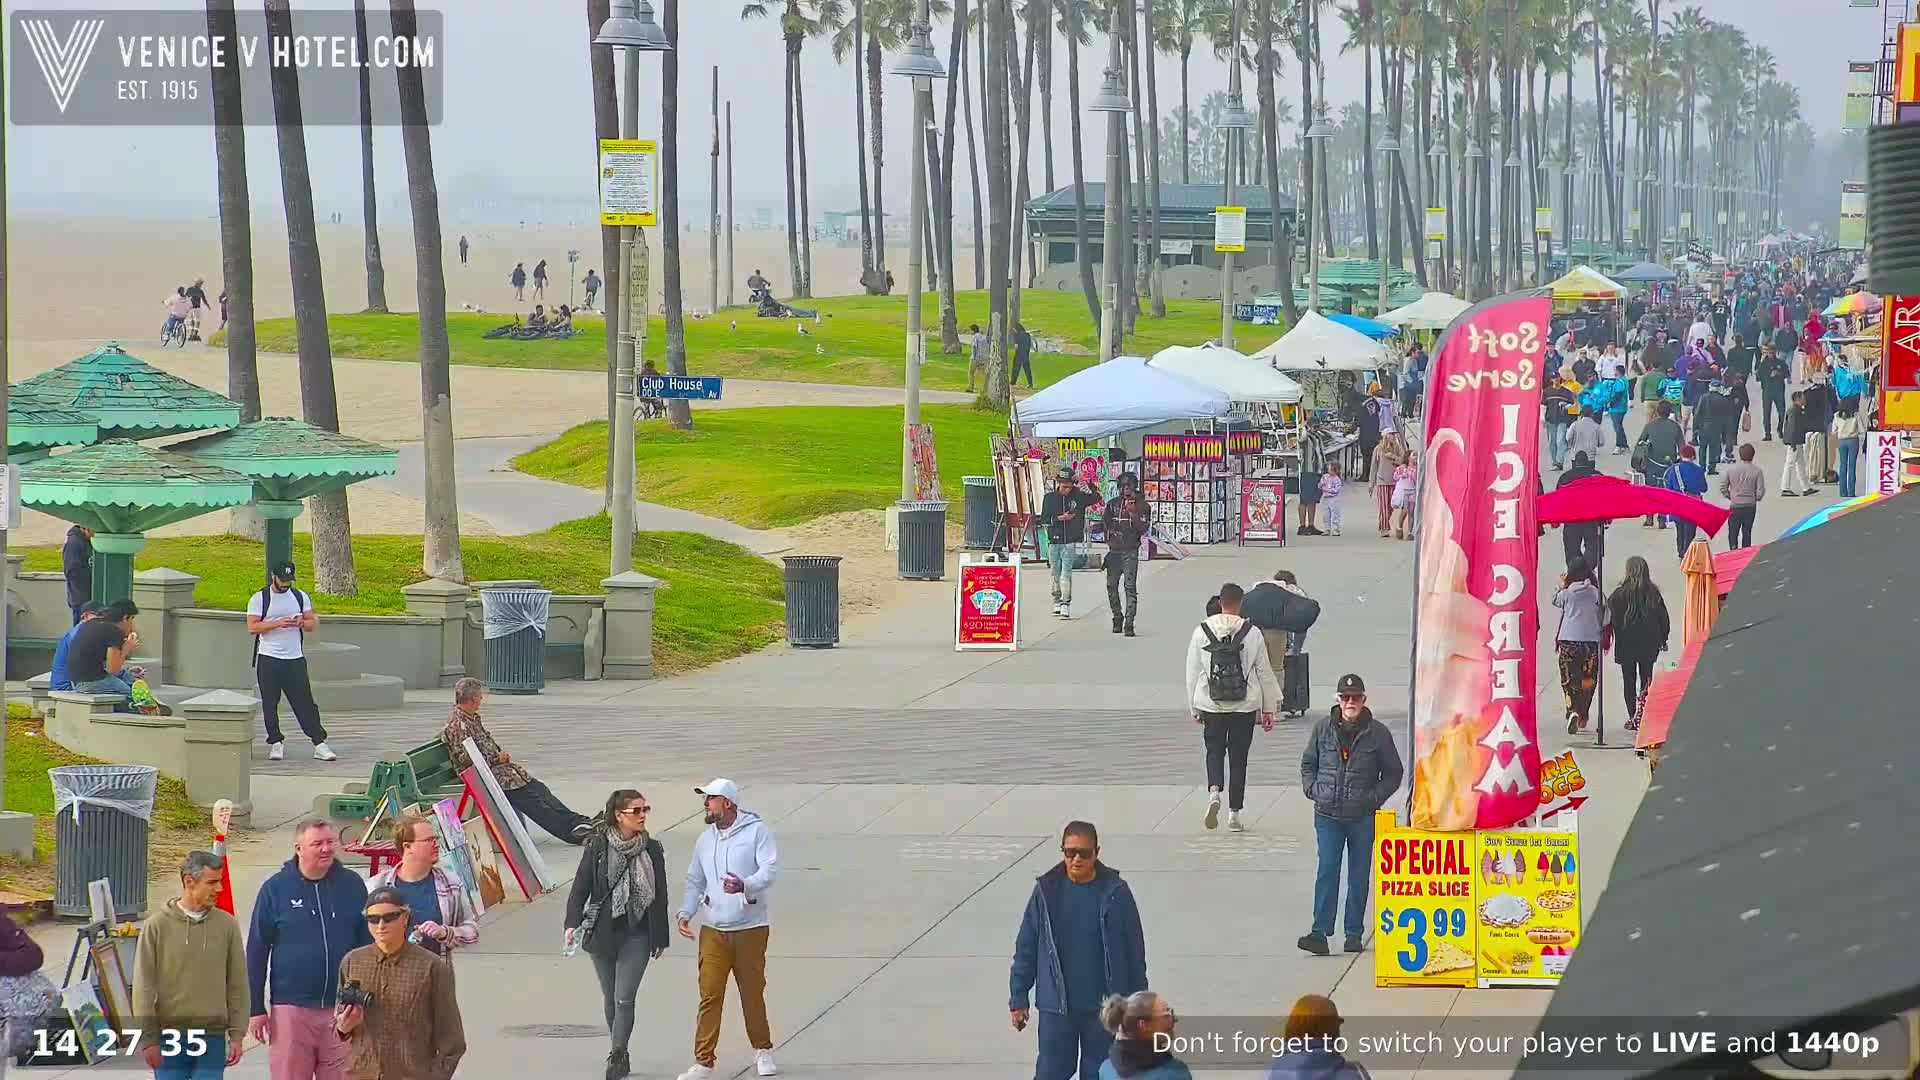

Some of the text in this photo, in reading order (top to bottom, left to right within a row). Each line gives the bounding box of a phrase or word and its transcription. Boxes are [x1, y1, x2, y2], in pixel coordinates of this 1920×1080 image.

[1894, 295, 1920, 357] AR
[642, 377, 702, 390] Club House
[1058, 439, 1084, 459] TTOO
[1144, 437, 1223, 461] HENNA TATTOO
[1229, 432, 1261, 451] ATTOO
[1879, 435, 1897, 496] MARKE
[1540, 751, 1577, 784] RN
[1540, 769, 1586, 805] OGS
[1380, 838, 1470, 875] SPECIAL
[1381, 880, 1470, 897] PIZZA SLICE
